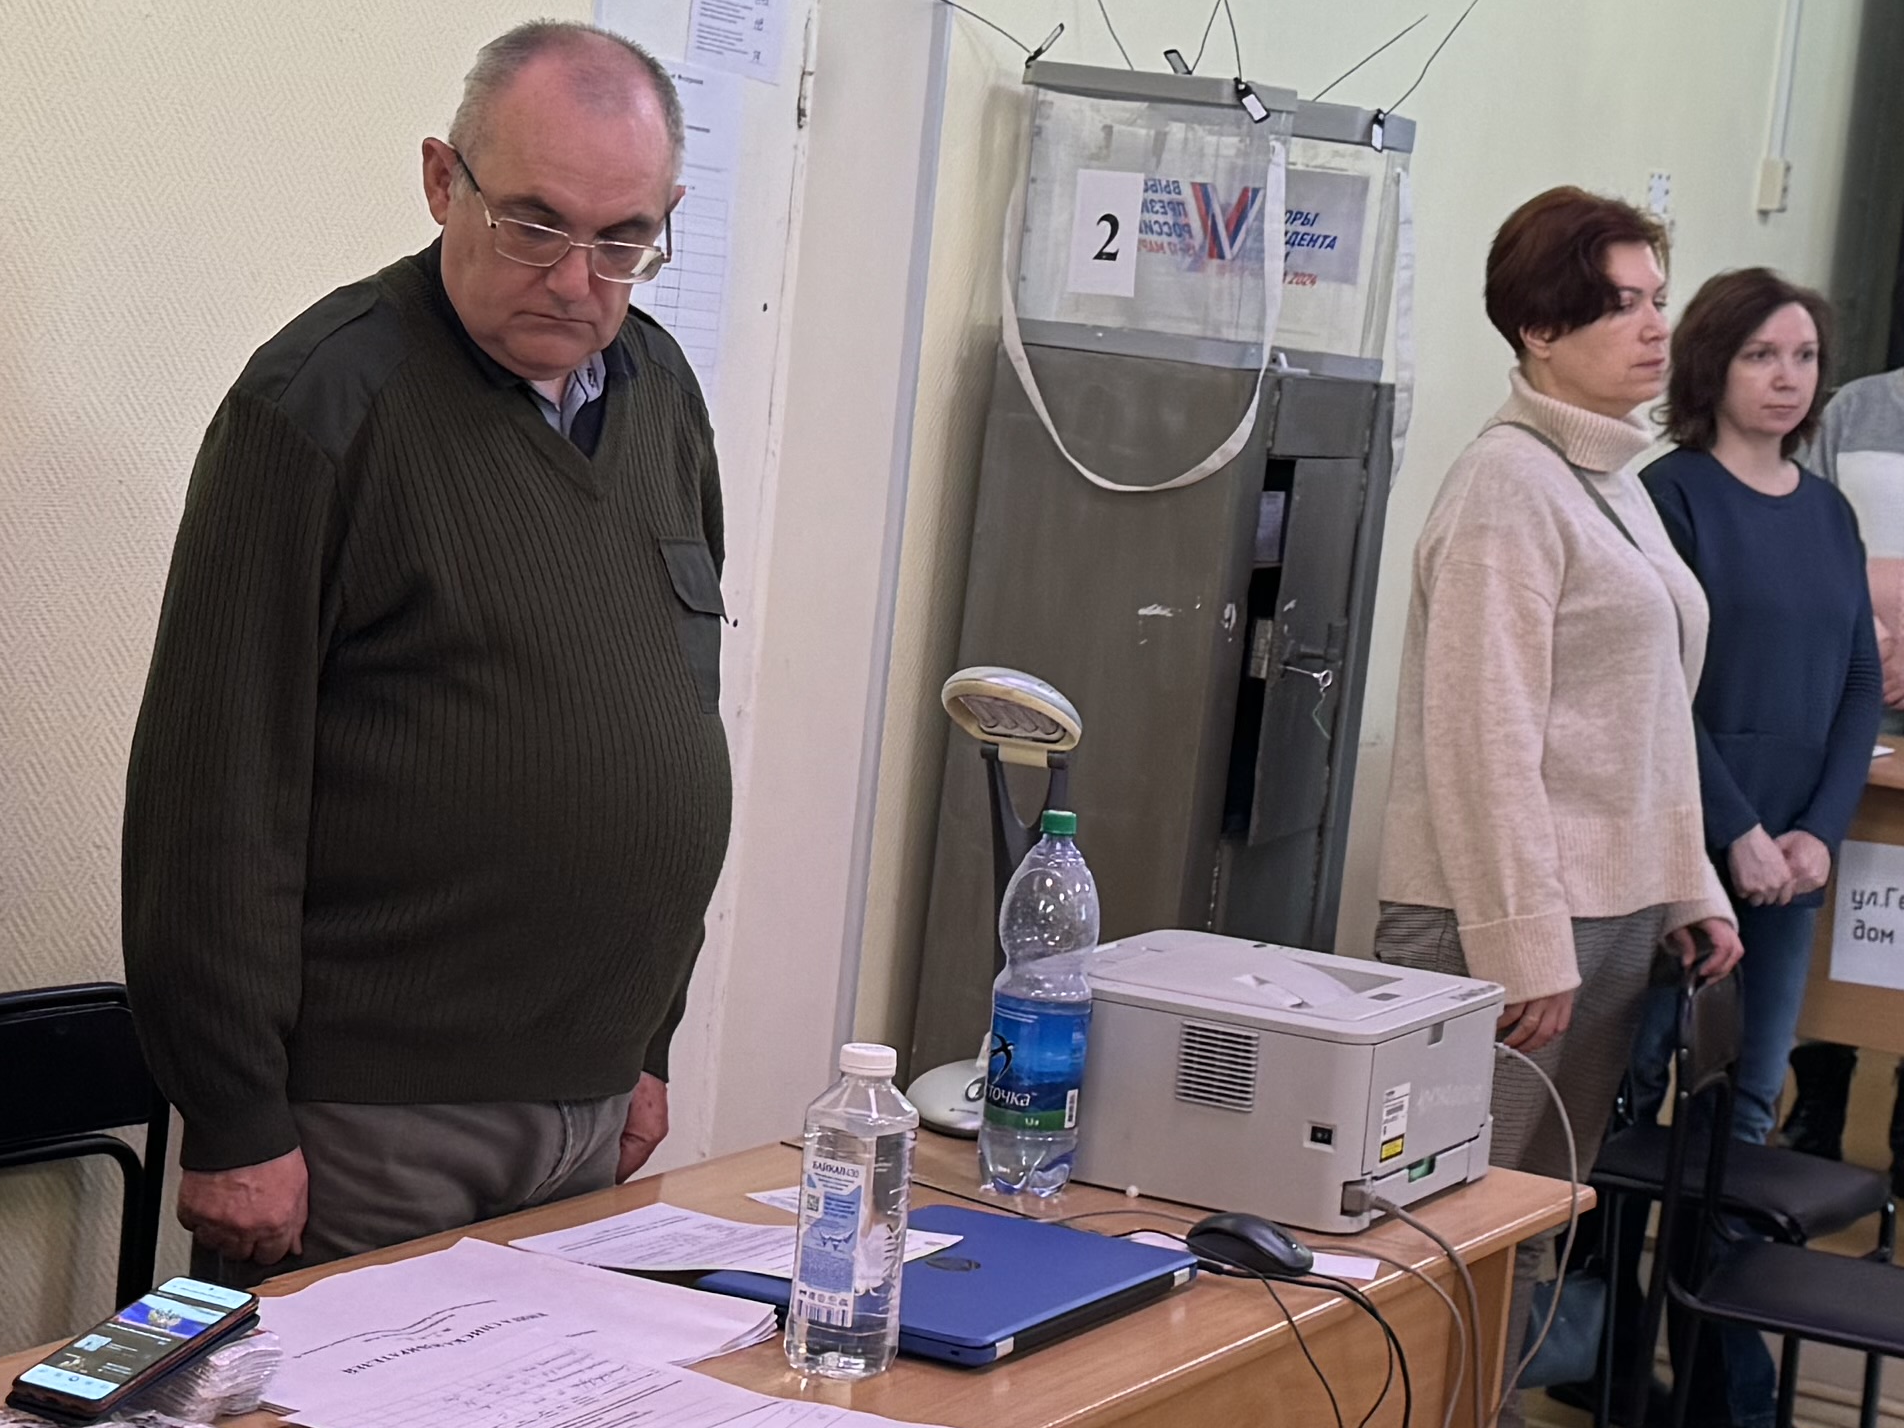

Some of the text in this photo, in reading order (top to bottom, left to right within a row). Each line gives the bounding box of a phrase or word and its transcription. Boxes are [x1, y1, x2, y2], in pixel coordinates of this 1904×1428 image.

[1093, 213, 1121, 262] 2
[1284, 230, 1338, 251] ДЕНТА
[1288, 272, 1318, 288] 2024
[1853, 919, 1895, 946] дом
